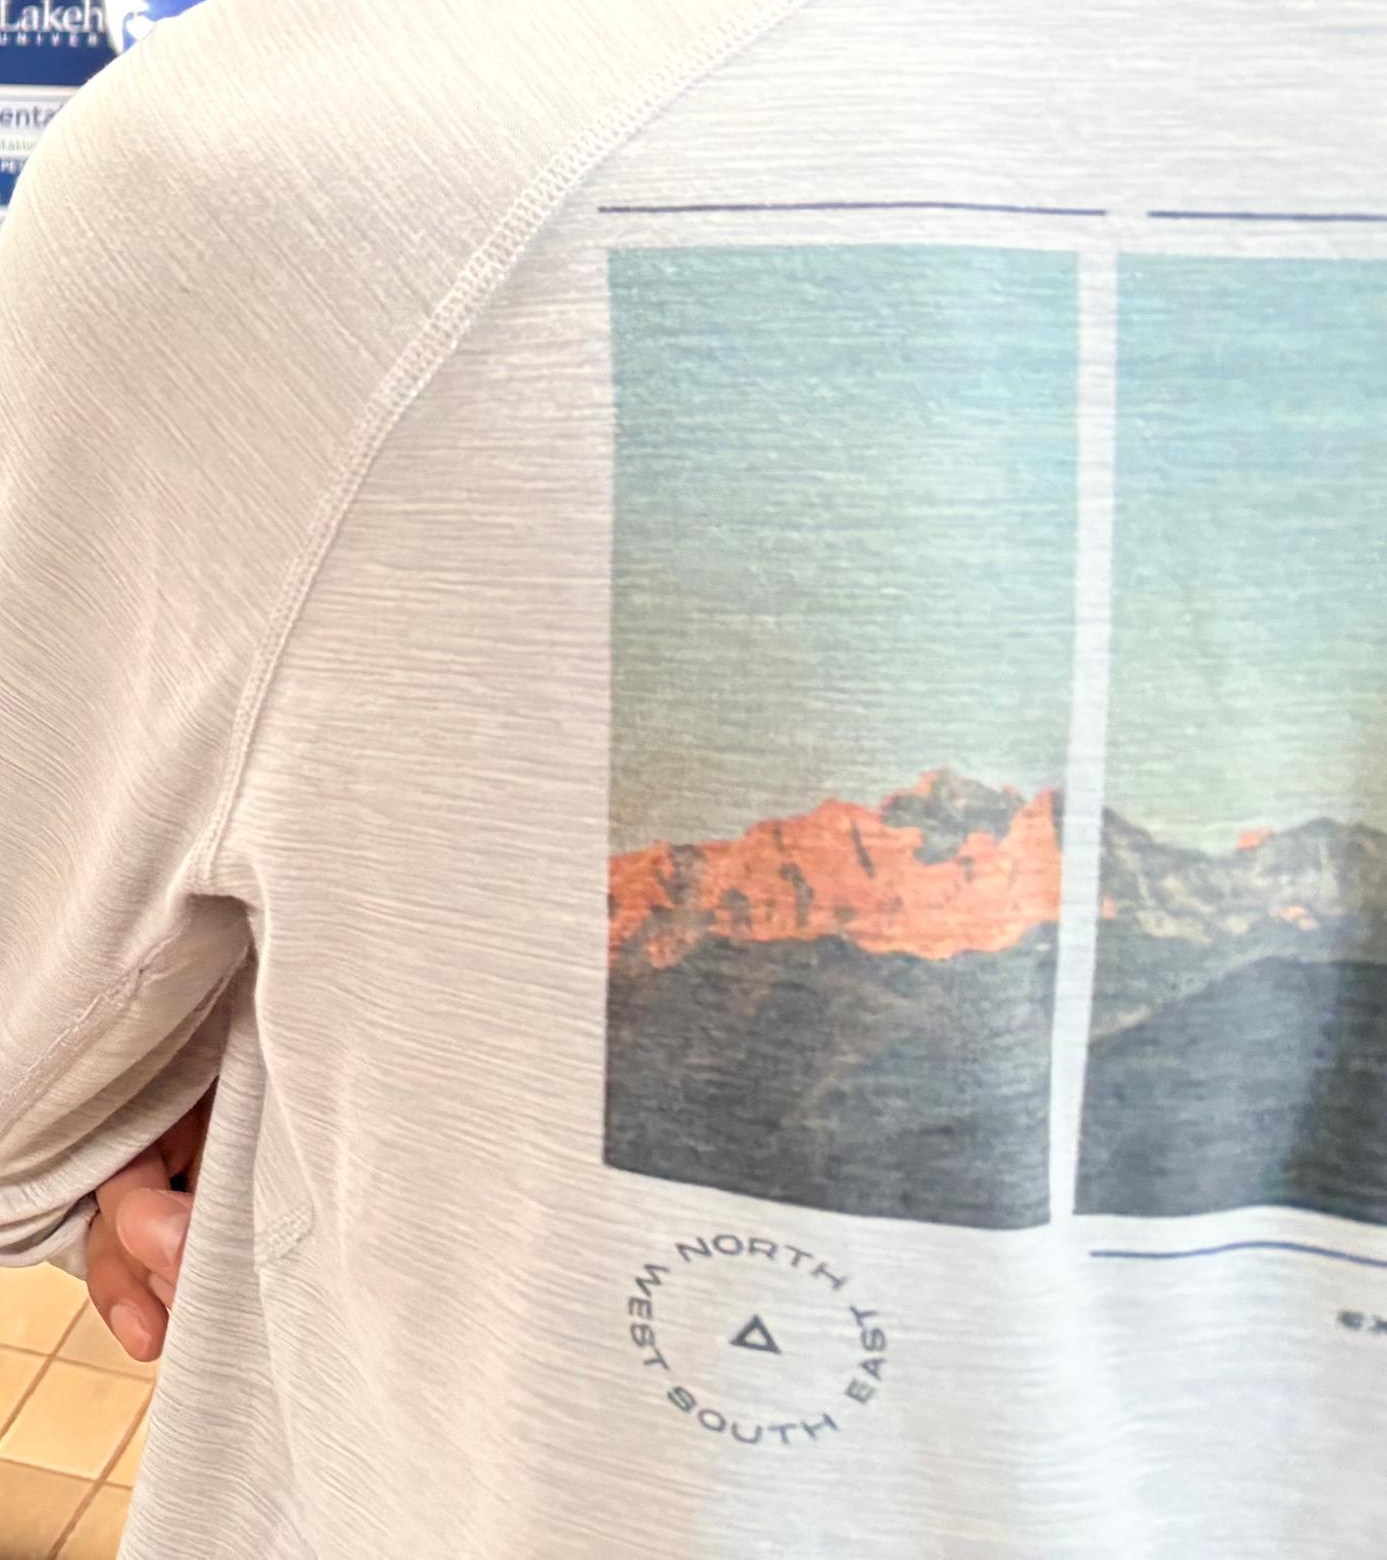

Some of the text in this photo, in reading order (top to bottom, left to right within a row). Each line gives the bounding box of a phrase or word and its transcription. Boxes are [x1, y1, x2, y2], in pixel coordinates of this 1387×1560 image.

[675, 1233, 849, 1292] NORTH
[628, 1264, 671, 1371] WEST
[843, 1305, 888, 1405] EAST
[666, 1386, 841, 1446] SOUTH
